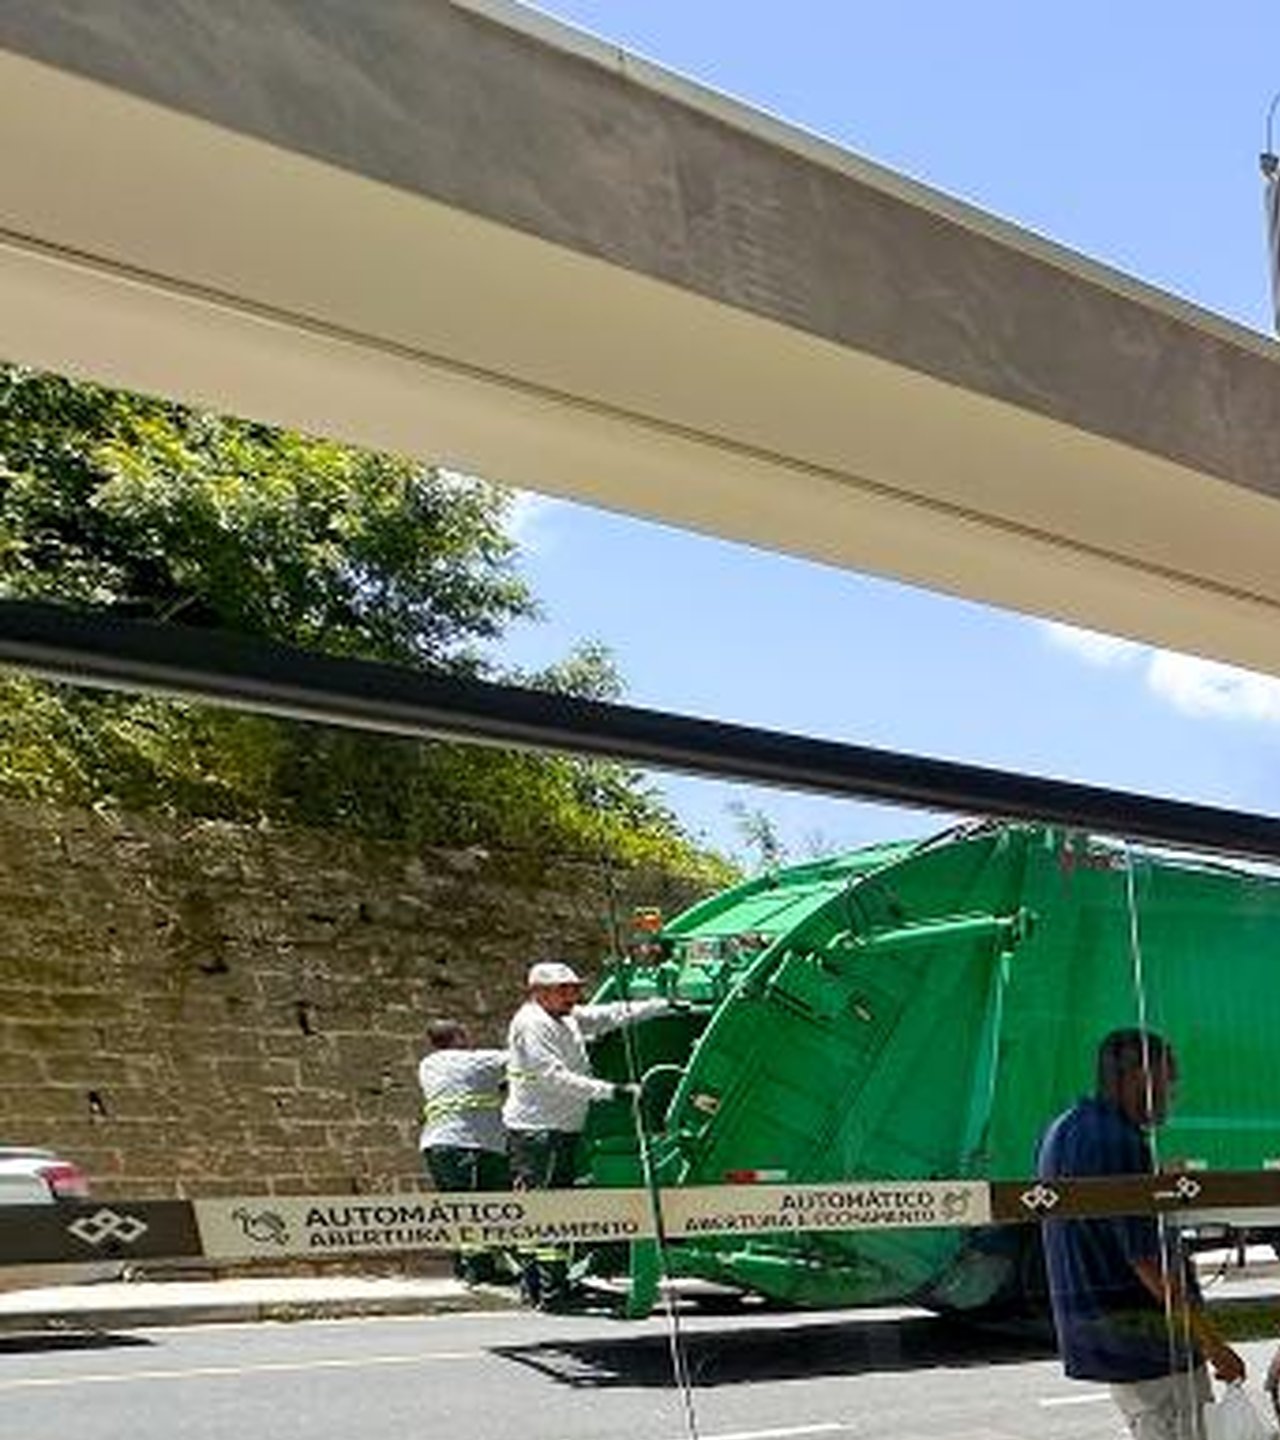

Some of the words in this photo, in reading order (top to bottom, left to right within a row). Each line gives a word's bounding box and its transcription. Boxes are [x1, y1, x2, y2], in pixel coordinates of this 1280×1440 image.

[305, 1200, 526, 1228] AUTOMÁTICO
[309, 1227, 453, 1248] ABERTURA
[459, 1227, 474, 1242] E
[482, 1220, 639, 1242] FECHAMENTO
